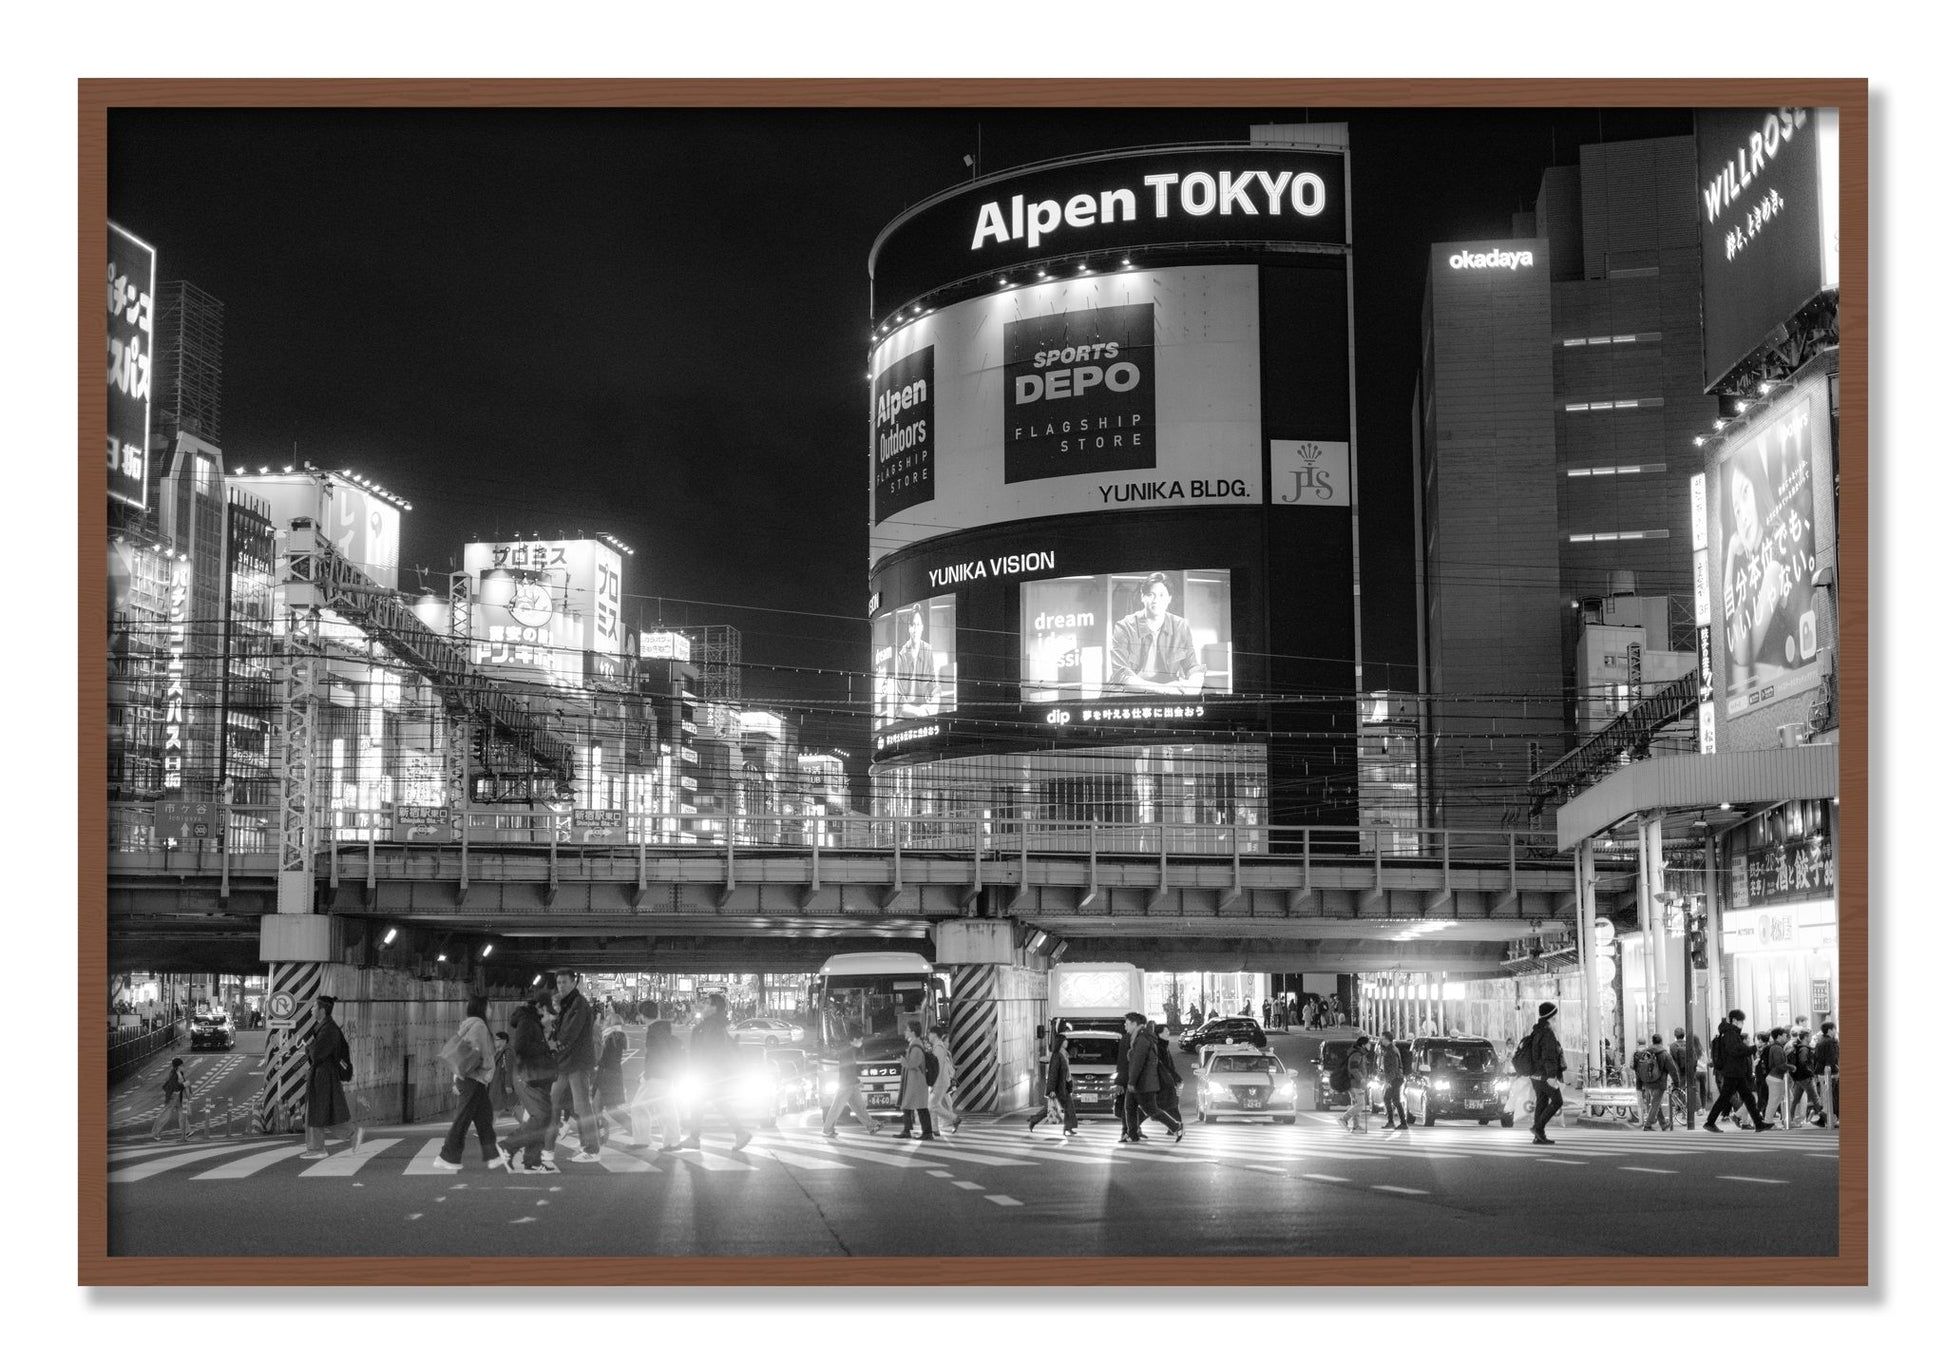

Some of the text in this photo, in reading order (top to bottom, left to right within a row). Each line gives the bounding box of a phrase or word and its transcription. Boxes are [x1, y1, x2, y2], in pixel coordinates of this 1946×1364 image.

[971, 171, 1326, 250] Alpen TOKYO
[1449, 248, 1534, 271] okadaya
[107, 334, 151, 403] スパス
[1033, 341, 1119, 369] SPORTS
[1015, 361, 1140, 405] DEPO
[877, 379, 927, 428] Alpen
[880, 419, 926, 464] Outdoors
[1015, 414, 1141, 440] FLAGSHIP
[1060, 433, 1141, 453] STORE
[876, 450, 928, 486] FLAGSHIP
[891, 468, 928, 493] STORE
[1099, 478, 1251, 503] YUNIKA BLDG.
[238, 552, 270, 574] SHISHA
[492, 547, 568, 566] プロミス
[929, 550, 1055, 587] YUNIKA VISION
[1724, 509, 1811, 620] 自分本位でも、
[598, 563, 618, 641] プロミス
[1726, 550, 1815, 653] いいじゃない。
[1034, 612, 1094, 630] dream
[1046, 706, 1205, 725] dip 夢を叶える仕事に出会おう
